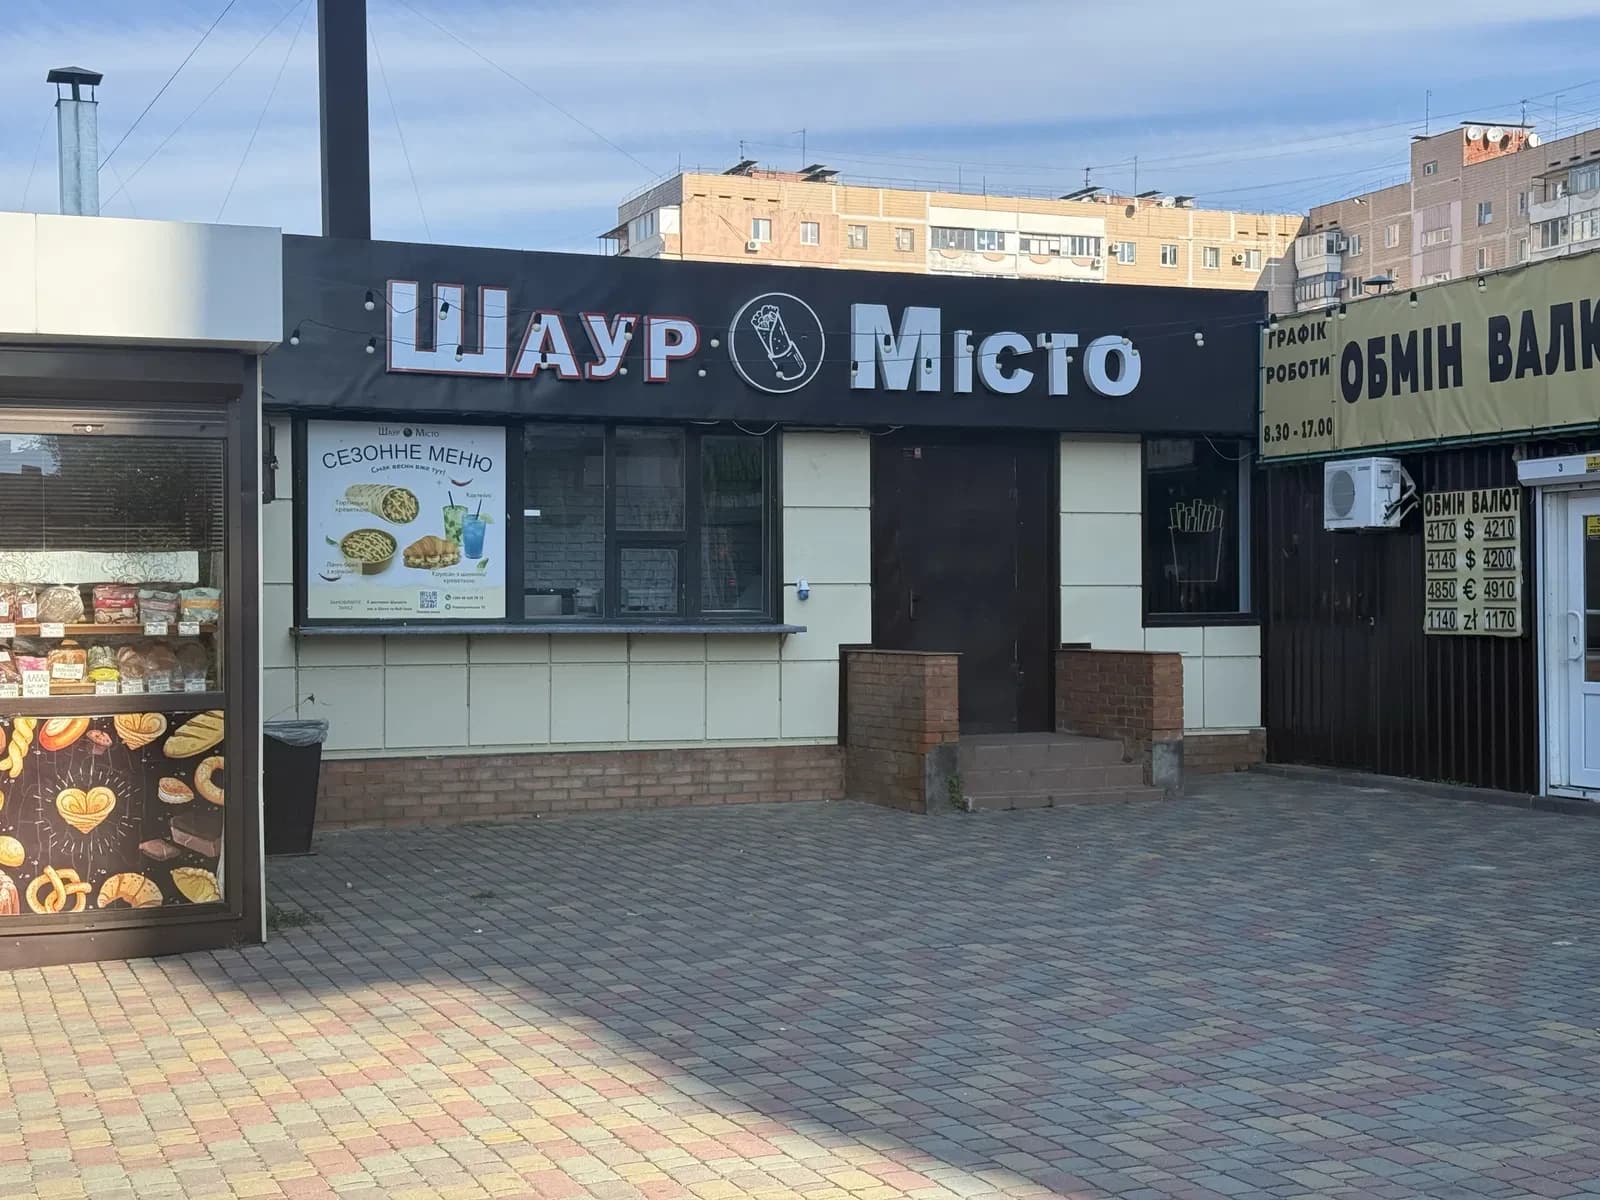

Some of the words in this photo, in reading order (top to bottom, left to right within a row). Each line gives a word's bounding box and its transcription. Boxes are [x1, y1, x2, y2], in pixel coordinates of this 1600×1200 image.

[1268, 321, 1327, 349] ГРАФІК
[1266, 356, 1330, 385] РОБОТИ
[1340, 322, 1464, 404] ОБМІН
[322, 444, 422, 469] СЕЗОННЕ
[429, 445, 493, 473] МЕНЮ
[1424, 492, 1465, 518] ОБМІН
[1471, 488, 1520, 515] ВАЛЮТ
[1427, 522, 1456, 540] 4170
[1464, 518, 1475, 541] $
[1484, 518, 1514, 538] 4210
[1427, 551, 1456, 569] 4140
[1465, 548, 1476, 570] $
[1483, 549, 1513, 568] 4200
[1427, 581, 1456, 599] 4850
[1462, 578, 1477, 600] €
[1484, 580, 1515, 598] 4910
[1427, 610, 1456, 629] 1140
[1485, 610, 1515, 628] 1170
